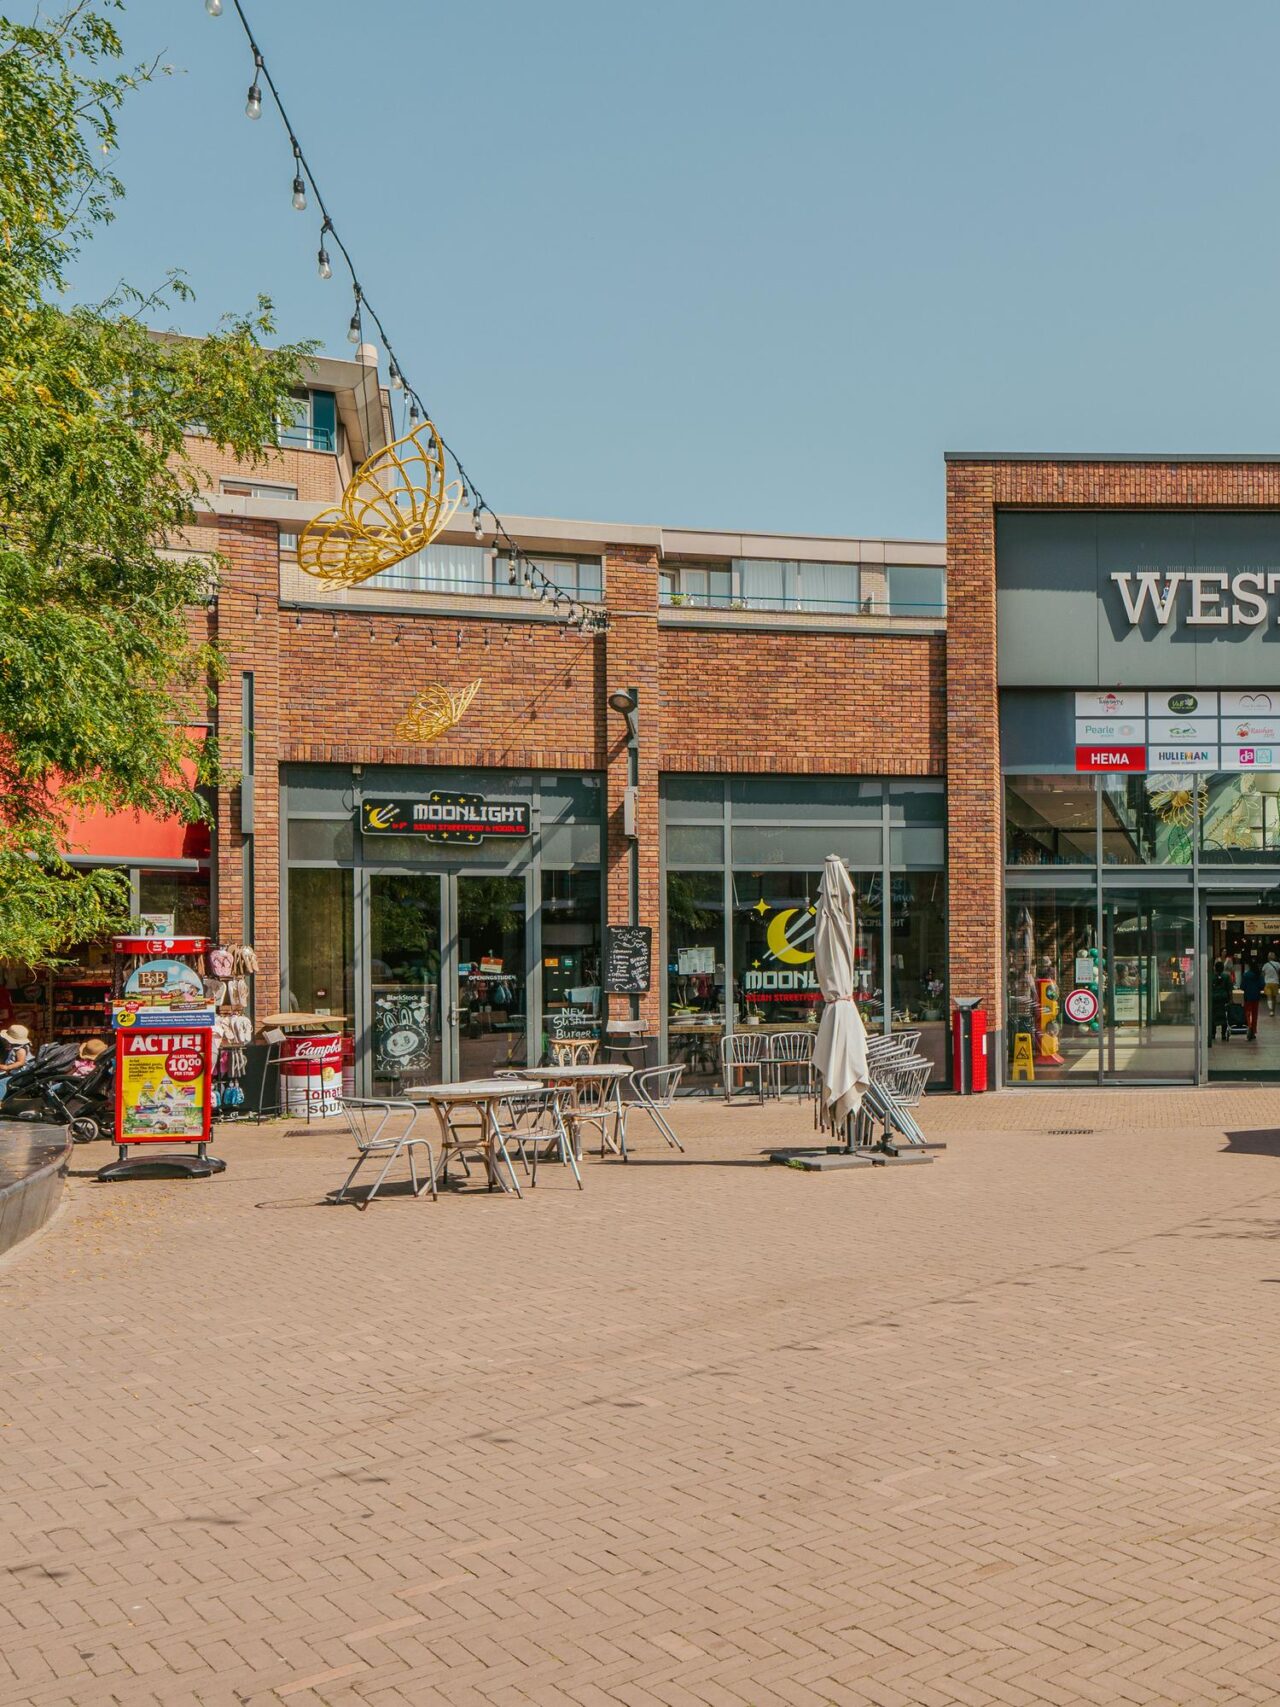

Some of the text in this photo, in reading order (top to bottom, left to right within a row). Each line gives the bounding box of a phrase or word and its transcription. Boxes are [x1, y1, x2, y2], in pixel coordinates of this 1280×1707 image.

[1085, 725, 1114, 734] Pearle
[1091, 753, 1130, 765] HEMA
[1158, 751, 1208, 761] HULLEMAN
[413, 804, 525, 823] MOONLIGHT
[745, 970, 872, 989] MOONLT
[562, 1007, 585, 1017] NEW
[129, 1034, 202, 1052] ACTIE!
